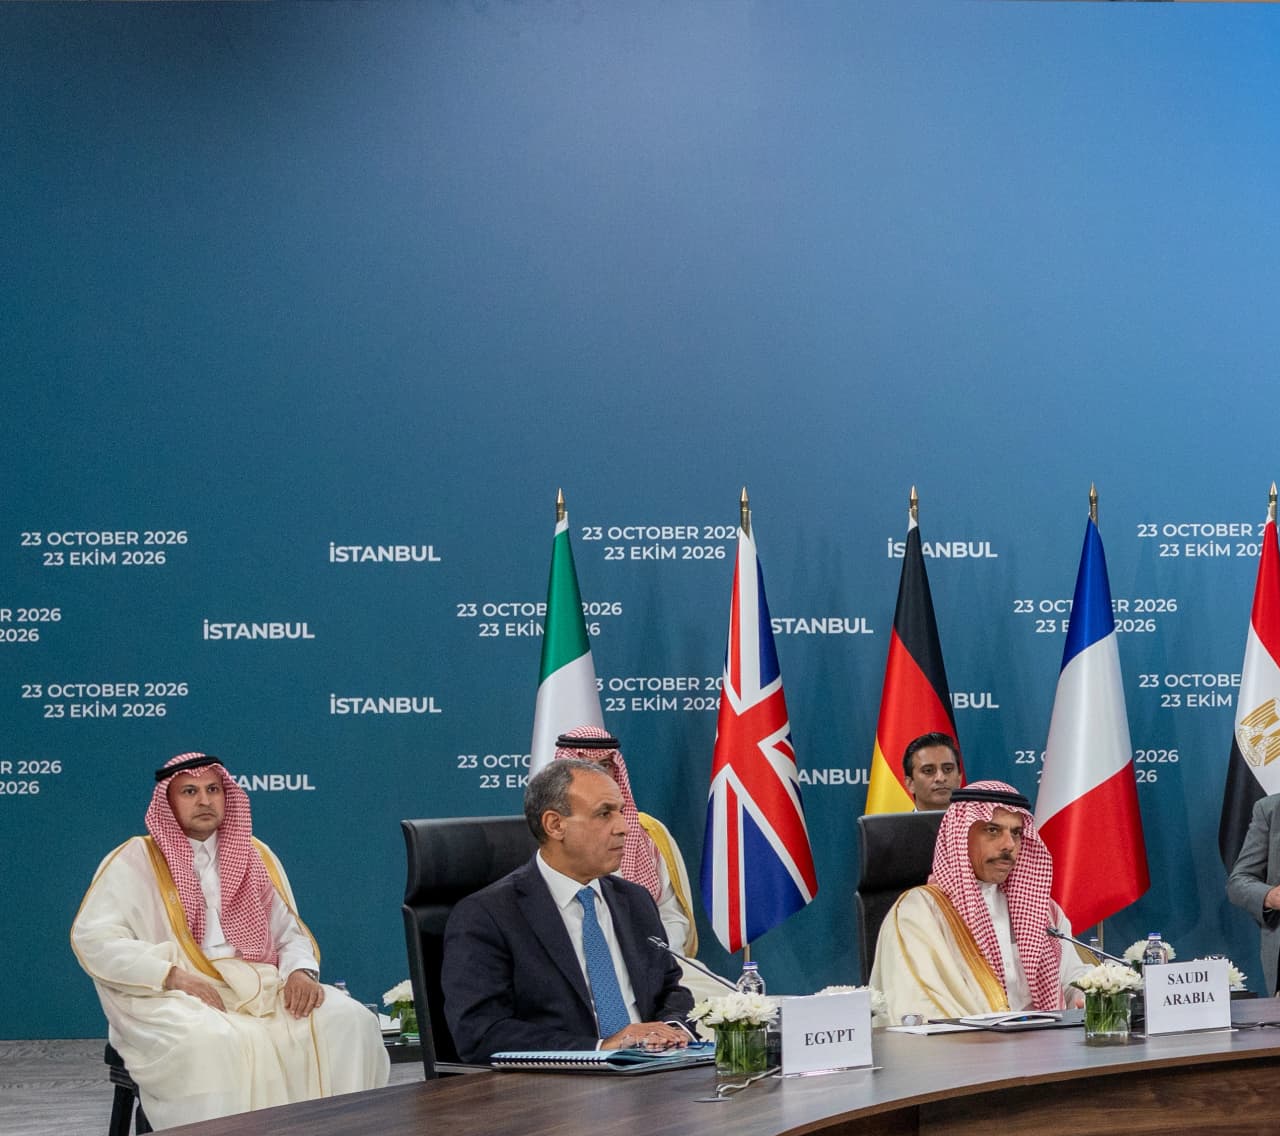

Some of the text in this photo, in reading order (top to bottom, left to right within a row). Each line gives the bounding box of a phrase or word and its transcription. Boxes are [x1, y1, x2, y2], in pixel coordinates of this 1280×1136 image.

[582, 526, 698, 540] 23 OCTOBER
[1137, 524, 1252, 537] 23 OCTOBER
[21, 531, 187, 545] 23 OCTOBER 2026
[330, 542, 441, 562] İSTANBUL
[605, 543, 725, 560] 23 EKİM 2026
[888, 538, 998, 558] İSANBUL
[1160, 540, 1230, 556] 23 EKİM
[43, 549, 165, 565] 23 EKİM 2026
[457, 604, 477, 617] 23
[483, 603, 547, 616] OCTOB
[1014, 599, 1177, 613] 23 2026
[17, 608, 61, 622] 2026
[204, 619, 315, 639] İSTANBUL
[479, 623, 499, 636] 23
[771, 618, 873, 634] STANBUL
[1036, 620, 1056, 632] 23
[0, 629, 39, 642] 2026
[609, 678, 699, 691] OCTOBER
[1139, 674, 1240, 687] 23 OCTOBE
[22, 683, 188, 698] 23 OCTOBER 2026
[331, 694, 442, 714] İSTANBUL
[606, 694, 677, 711] 23 EKİM
[1161, 691, 1232, 707] 23 EKİM
[44, 701, 166, 718] 23 EKİM 2026
[458, 755, 478, 768] 23
[1015, 751, 1035, 763] 23
[1136, 750, 1178, 762] 2026
[18, 760, 61, 774] 2026
[0, 781, 39, 794] 2026
[480, 775, 500, 788] 23
[1167, 971, 1209, 984] SAUDI
[1165, 992, 1215, 1005] ARABIA
[805, 1029, 855, 1046] EGYPT
